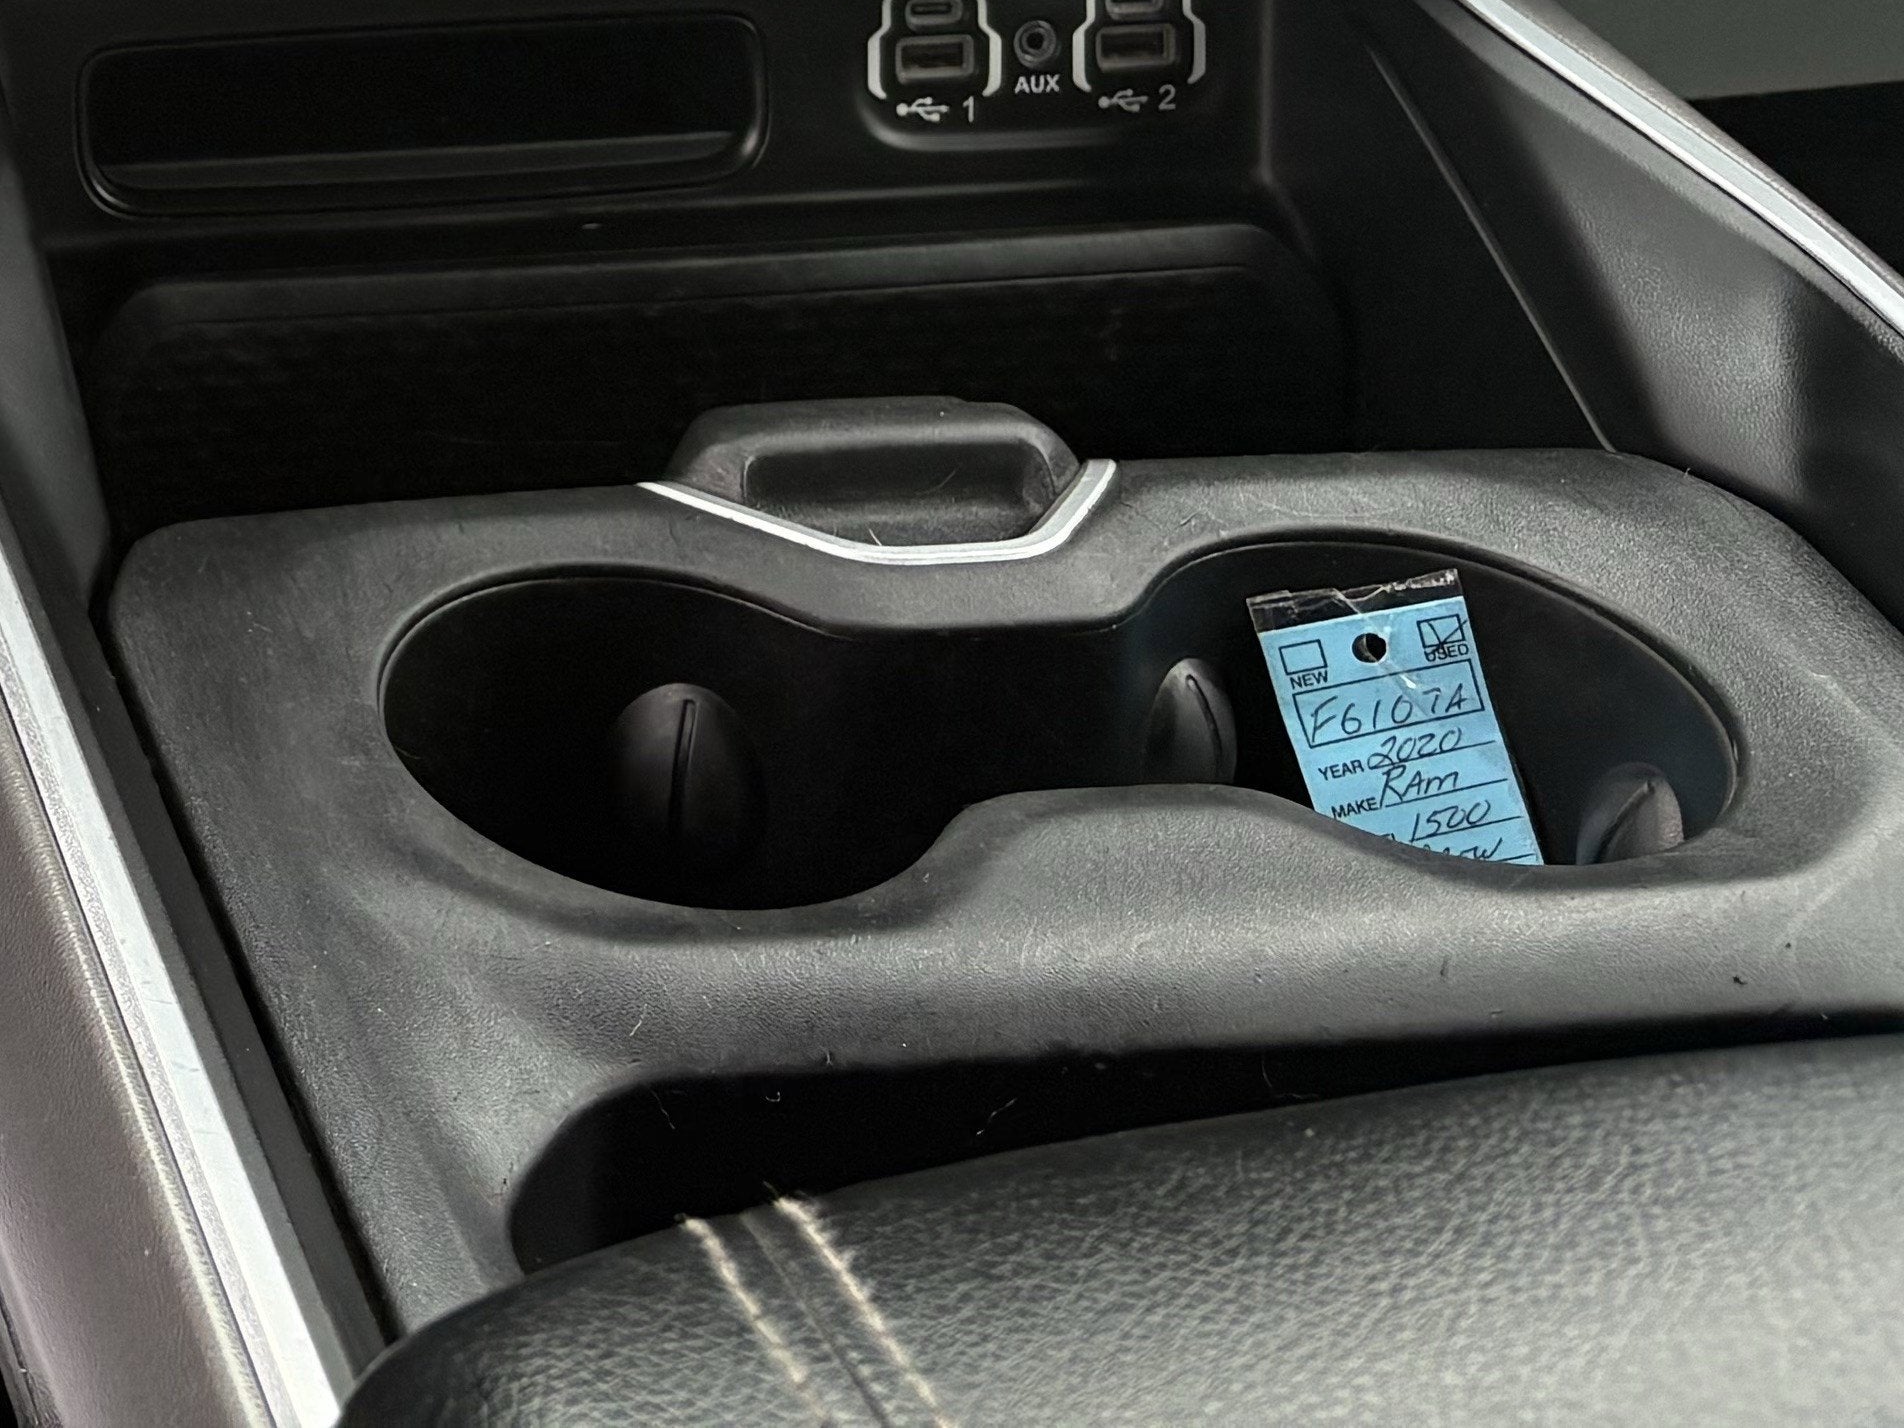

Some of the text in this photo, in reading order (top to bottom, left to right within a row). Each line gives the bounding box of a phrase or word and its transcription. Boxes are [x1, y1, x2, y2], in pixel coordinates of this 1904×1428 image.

[1014, 74, 1060, 94] AUX
[962, 95, 974, 124] 1
[1158, 84, 1177, 111] 2
[1425, 643, 1469, 662] USED
[1291, 671, 1329, 690] NEW
[1319, 727, 1462, 781] YEAR 2020
[1332, 796, 1379, 818] MAKE
[1411, 800, 1490, 842] 1500
